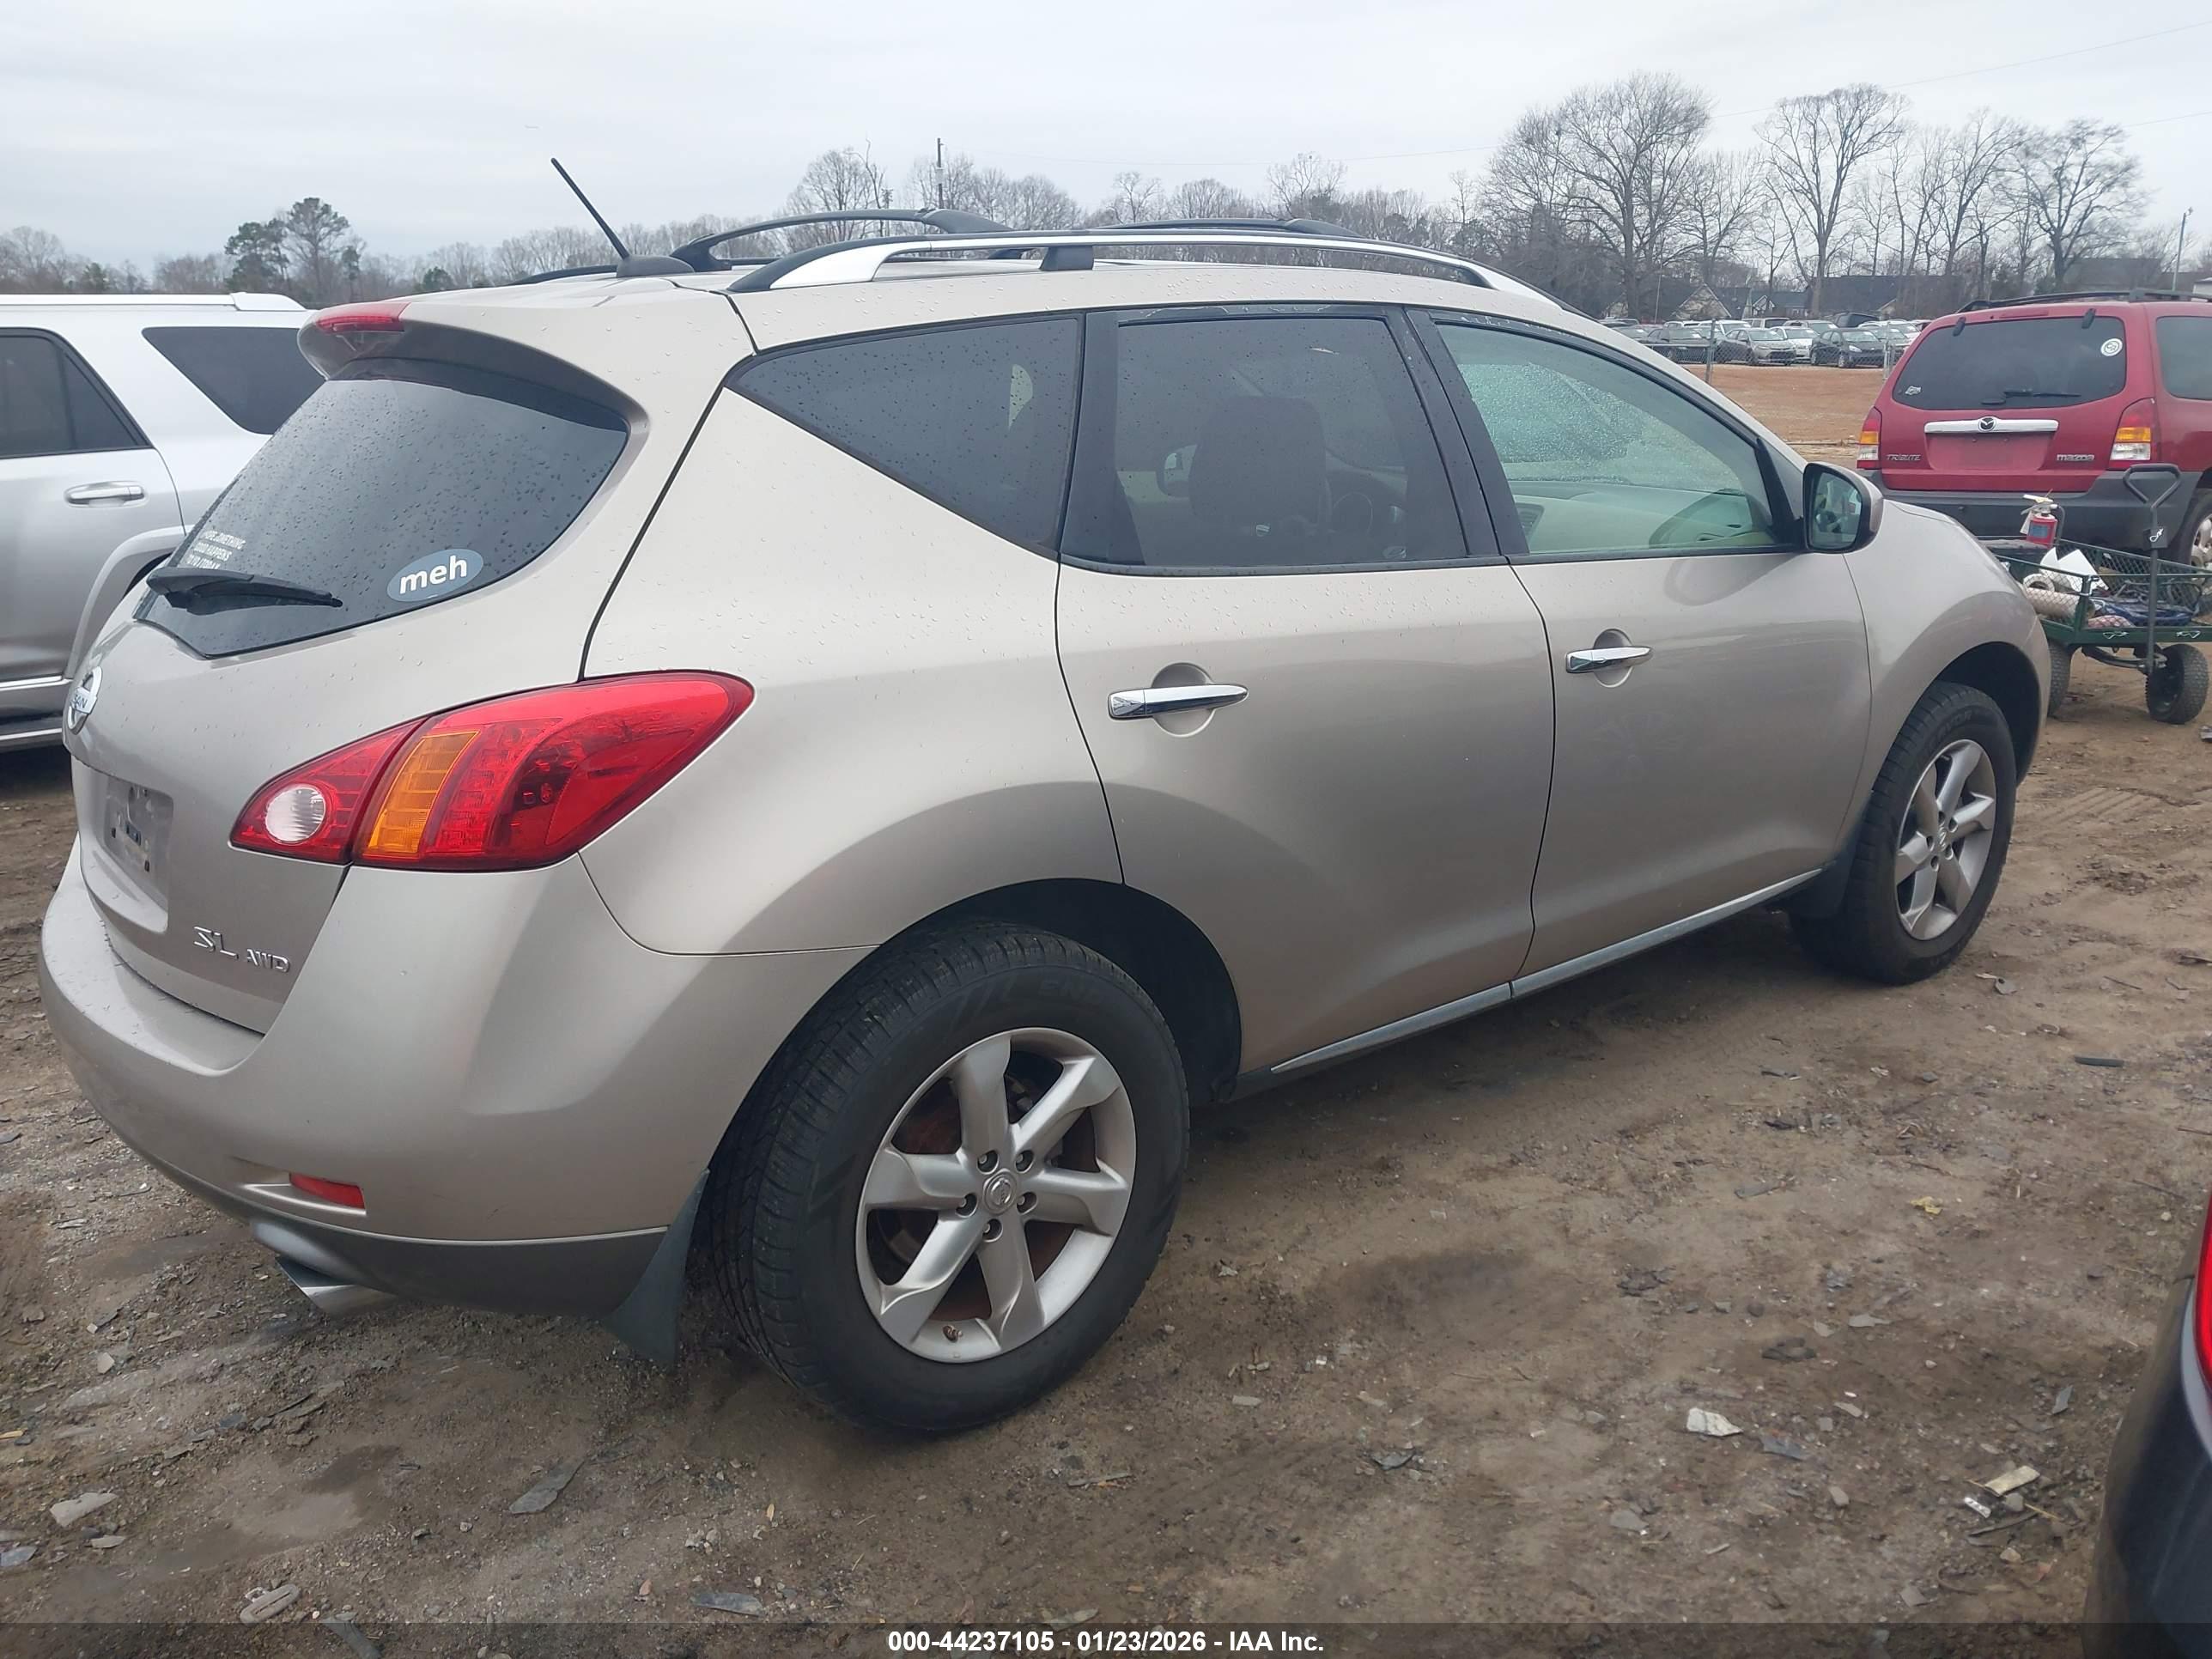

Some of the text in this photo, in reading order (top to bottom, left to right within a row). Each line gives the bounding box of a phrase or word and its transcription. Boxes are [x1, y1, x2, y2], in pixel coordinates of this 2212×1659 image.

[399, 555, 467, 594] meh
[193, 927, 290, 972] SL AWD
